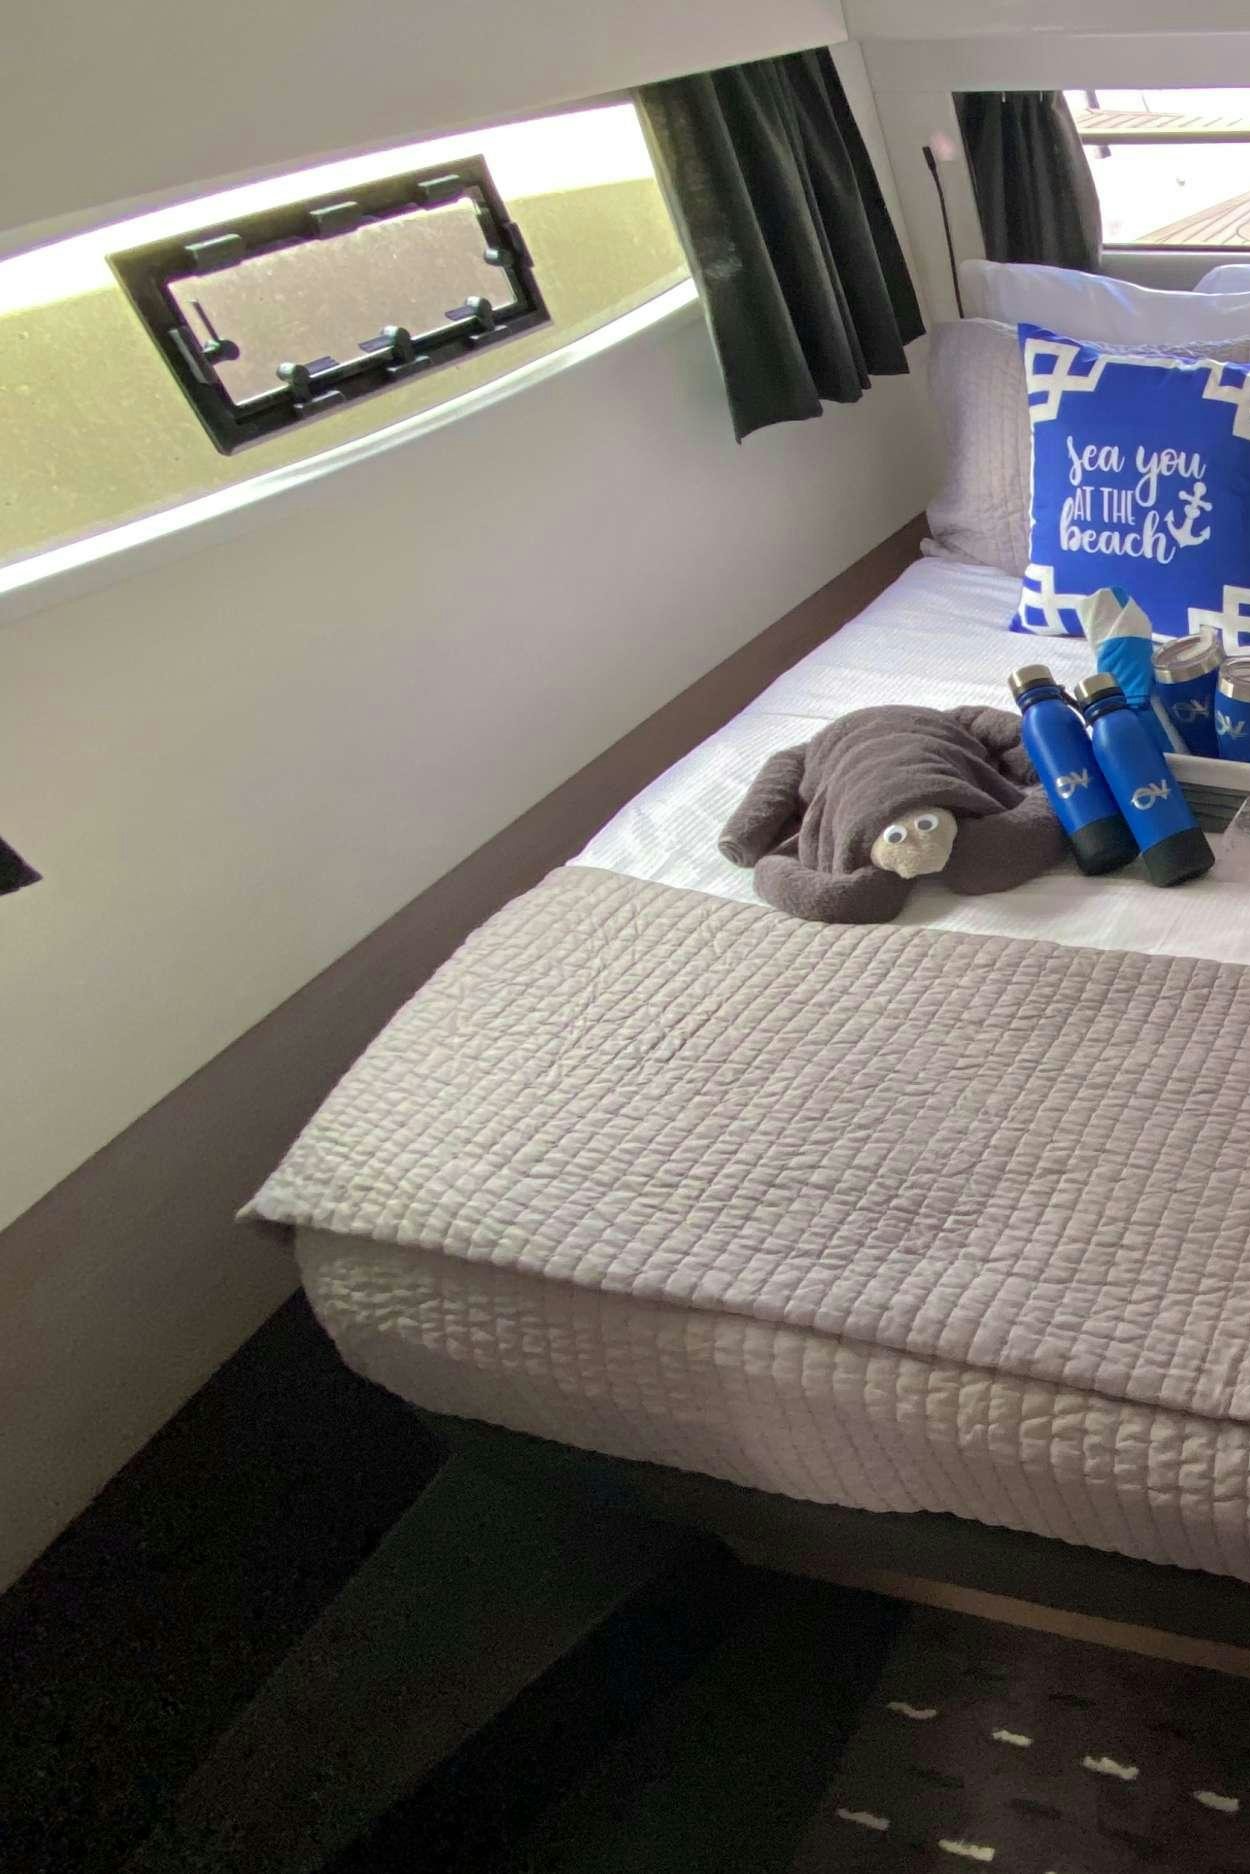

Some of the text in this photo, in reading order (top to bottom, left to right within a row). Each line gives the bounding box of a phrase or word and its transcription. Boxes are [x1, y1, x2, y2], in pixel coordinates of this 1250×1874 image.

[1074, 486, 1136, 525] AT THE
[1135, 445, 1207, 507] you
[1059, 497, 1176, 564] beach
